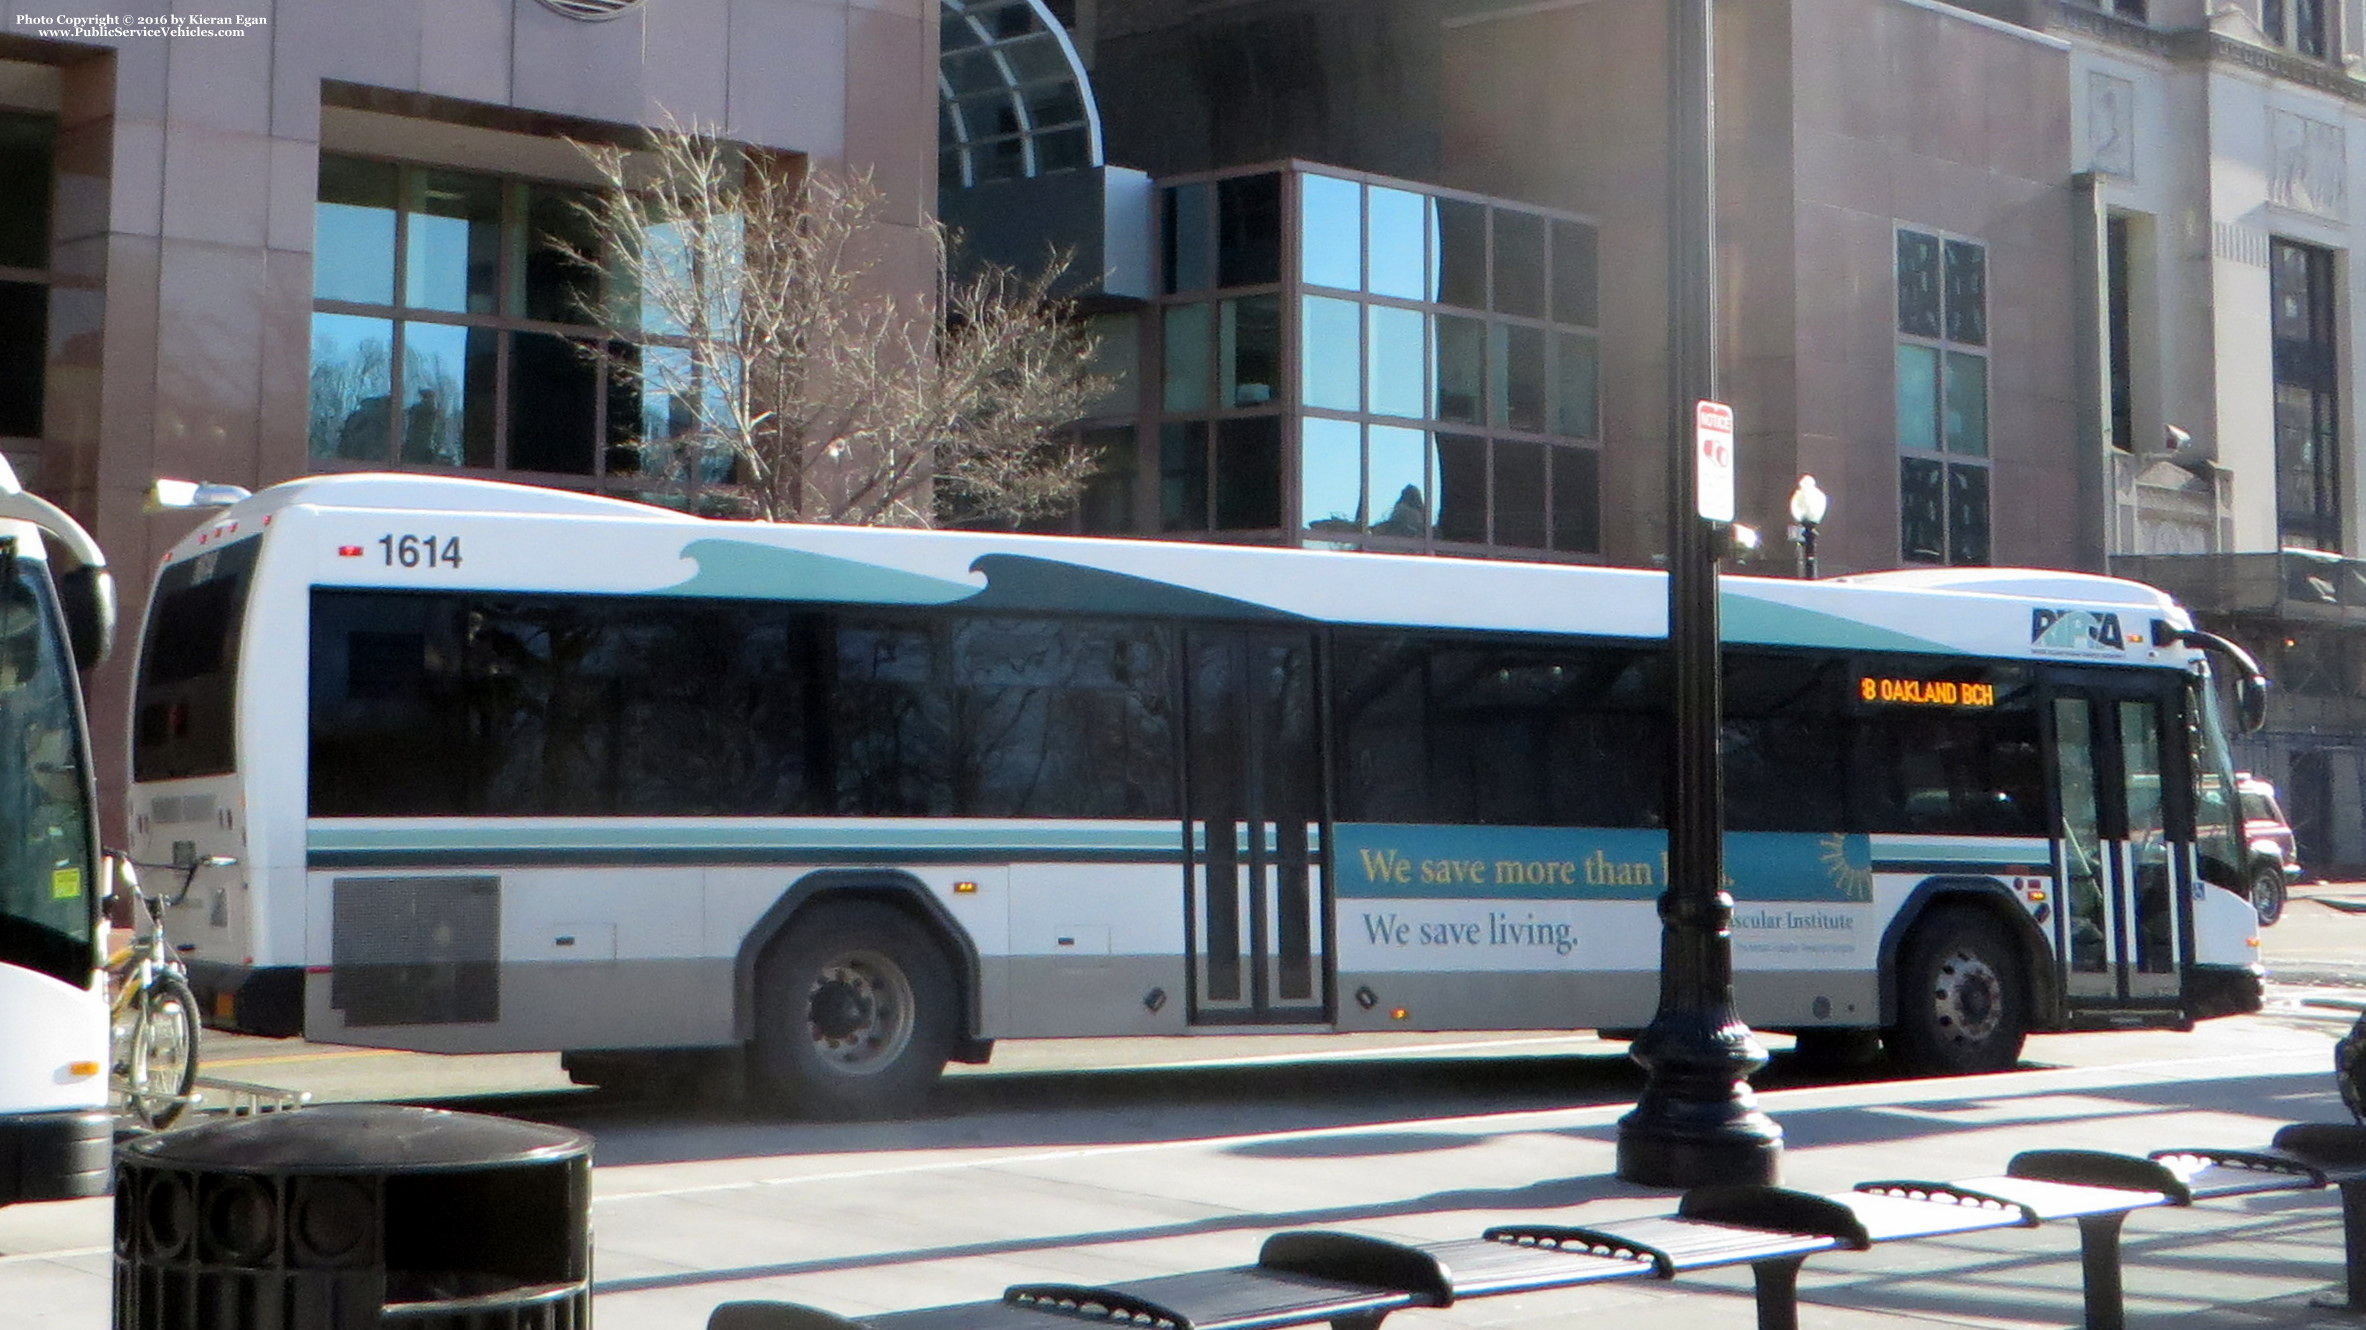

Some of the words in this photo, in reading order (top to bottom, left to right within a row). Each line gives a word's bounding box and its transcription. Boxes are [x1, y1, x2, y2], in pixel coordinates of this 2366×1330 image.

[378, 533, 463, 569] 1614
[1881, 679, 1957, 704] OAKLAND
[1960, 682, 1994, 706] BCH
[1360, 849, 1412, 884] We
[1421, 860, 1485, 884] save
[1495, 861, 1576, 885] more
[1585, 849, 1654, 886] than
[1362, 912, 1410, 946] We
[1420, 921, 1481, 945] save
[1786, 910, 1854, 930] Institute
